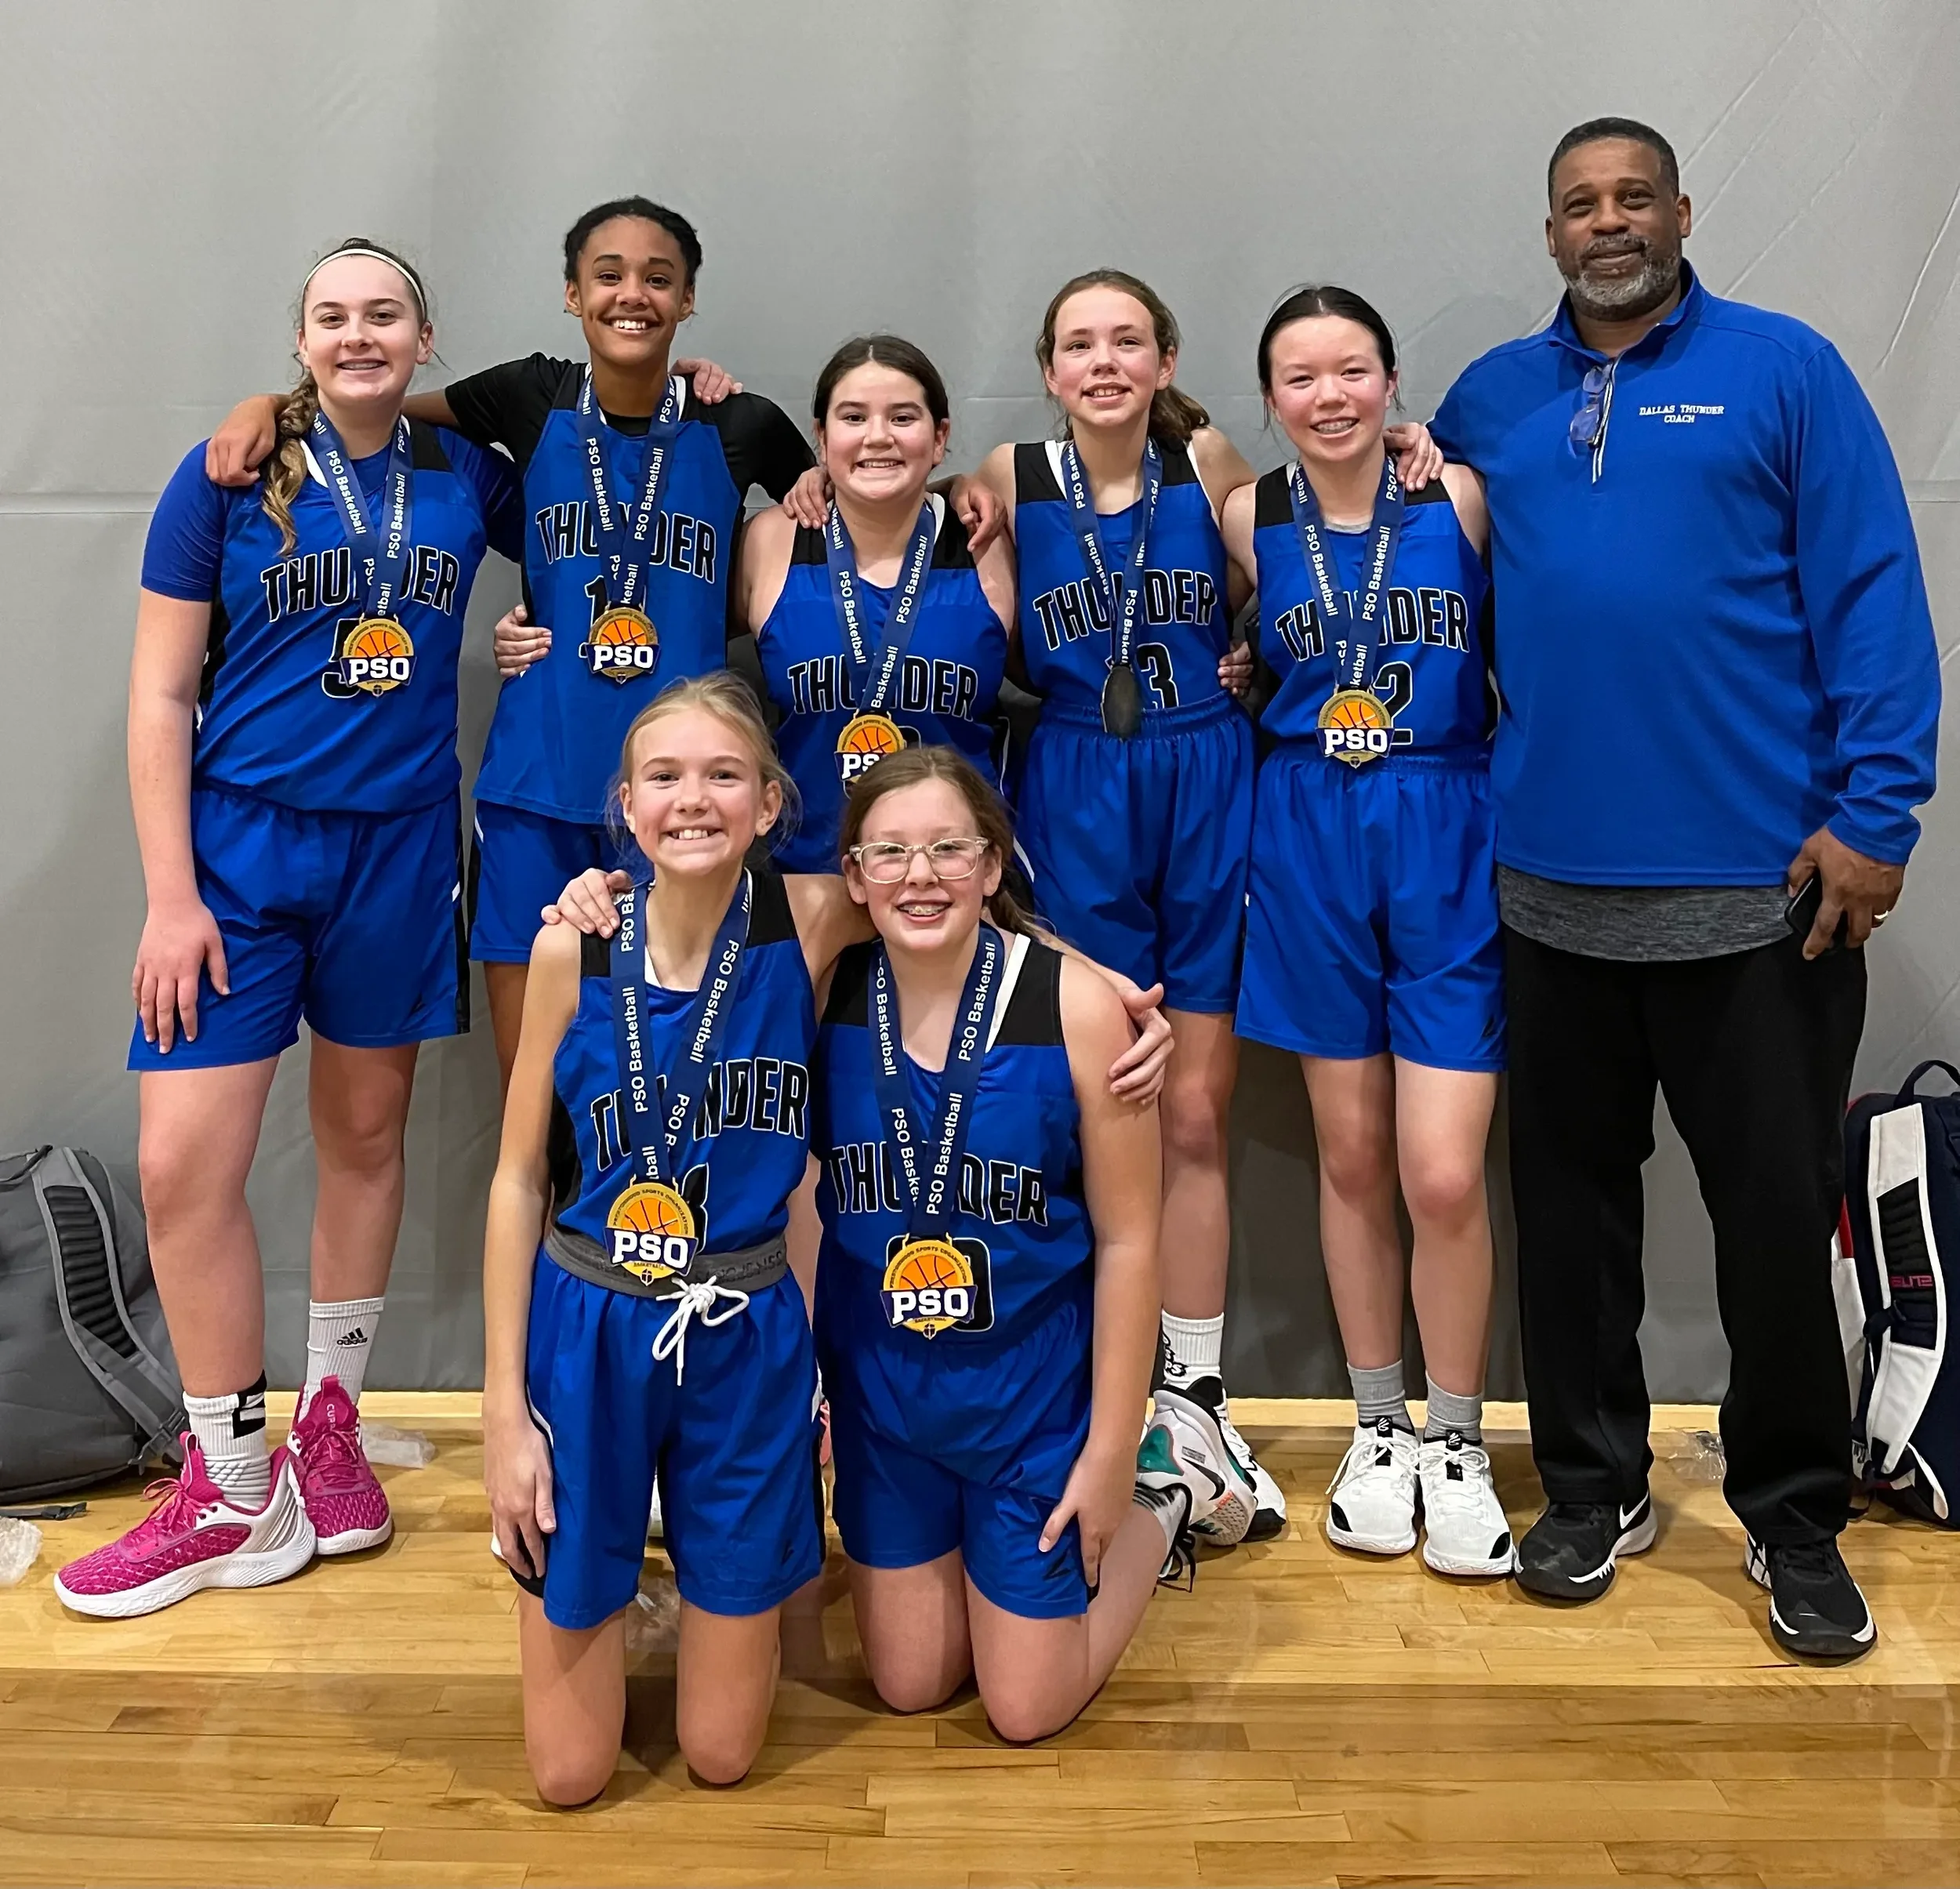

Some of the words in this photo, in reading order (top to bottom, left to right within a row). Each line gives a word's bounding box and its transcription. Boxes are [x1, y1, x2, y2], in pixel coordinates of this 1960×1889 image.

[659, 396, 673, 423] PSO
[1639, 404, 1675, 415] DALLAS
[1679, 404, 1725, 415] THUNDER
[1664, 414, 1695, 423] COACH
[586, 437, 601, 465] PSO
[326, 449, 345, 475] PSO
[336, 475, 367, 535] Basketball
[591, 466, 615, 531] Basketball
[640, 447, 664, 512] Basketball
[1073, 482, 1086, 509] PSO
[1385, 476, 1397, 502] PSO
[390, 473, 406, 531] Basketball
[387, 532, 401, 560] PSO
[535, 501, 717, 585] THUDER
[633, 513, 650, 541] PSO
[831, 507, 844, 549] ketball
[1305, 524, 1320, 552] PSO
[1368, 525, 1391, 590] Basketball
[260, 546, 460, 624] THUDER
[620, 563, 639, 604] ketball
[838, 570, 853, 598] PSO
[895, 596, 913, 625] PSO
[904, 534, 928, 595] Basketball
[1312, 553, 1338, 617] Basketball
[377, 582, 392, 616] etball
[1125, 589, 1138, 616] PSO
[1362, 593, 1377, 622] PSO
[843, 599, 866, 665] Basketball
[1275, 586, 1470, 662] THDER
[348, 657, 410, 686] PSO
[593, 645, 654, 672] PSO
[870, 645, 899, 709] Basketball
[1350, 643, 1368, 687] ketball
[786, 654, 978, 722] THUDER
[1323, 728, 1388, 755] PSO
[841, 753, 880, 780] PS
[621, 918, 635, 952] PSO
[719, 939, 740, 976] PSO
[967, 941, 996, 1024] Basketball
[622, 986, 643, 1072] Basketball
[689, 977, 728, 1064] Basketball
[877, 992, 898, 1076] Basketball
[958, 1025, 978, 1062] PSO
[631, 1075, 648, 1113] PSO
[668, 1093, 691, 1129] PSO
[590, 1057, 809, 1172] TNDER
[891, 1108, 910, 1144] PSO
[934, 1092, 964, 1177] Basketball
[829, 1141, 1048, 1227] THUDER
[926, 1179, 945, 1215] PSO
[612, 1229, 688, 1269] PSO
[891, 1287, 969, 1325] PSO
